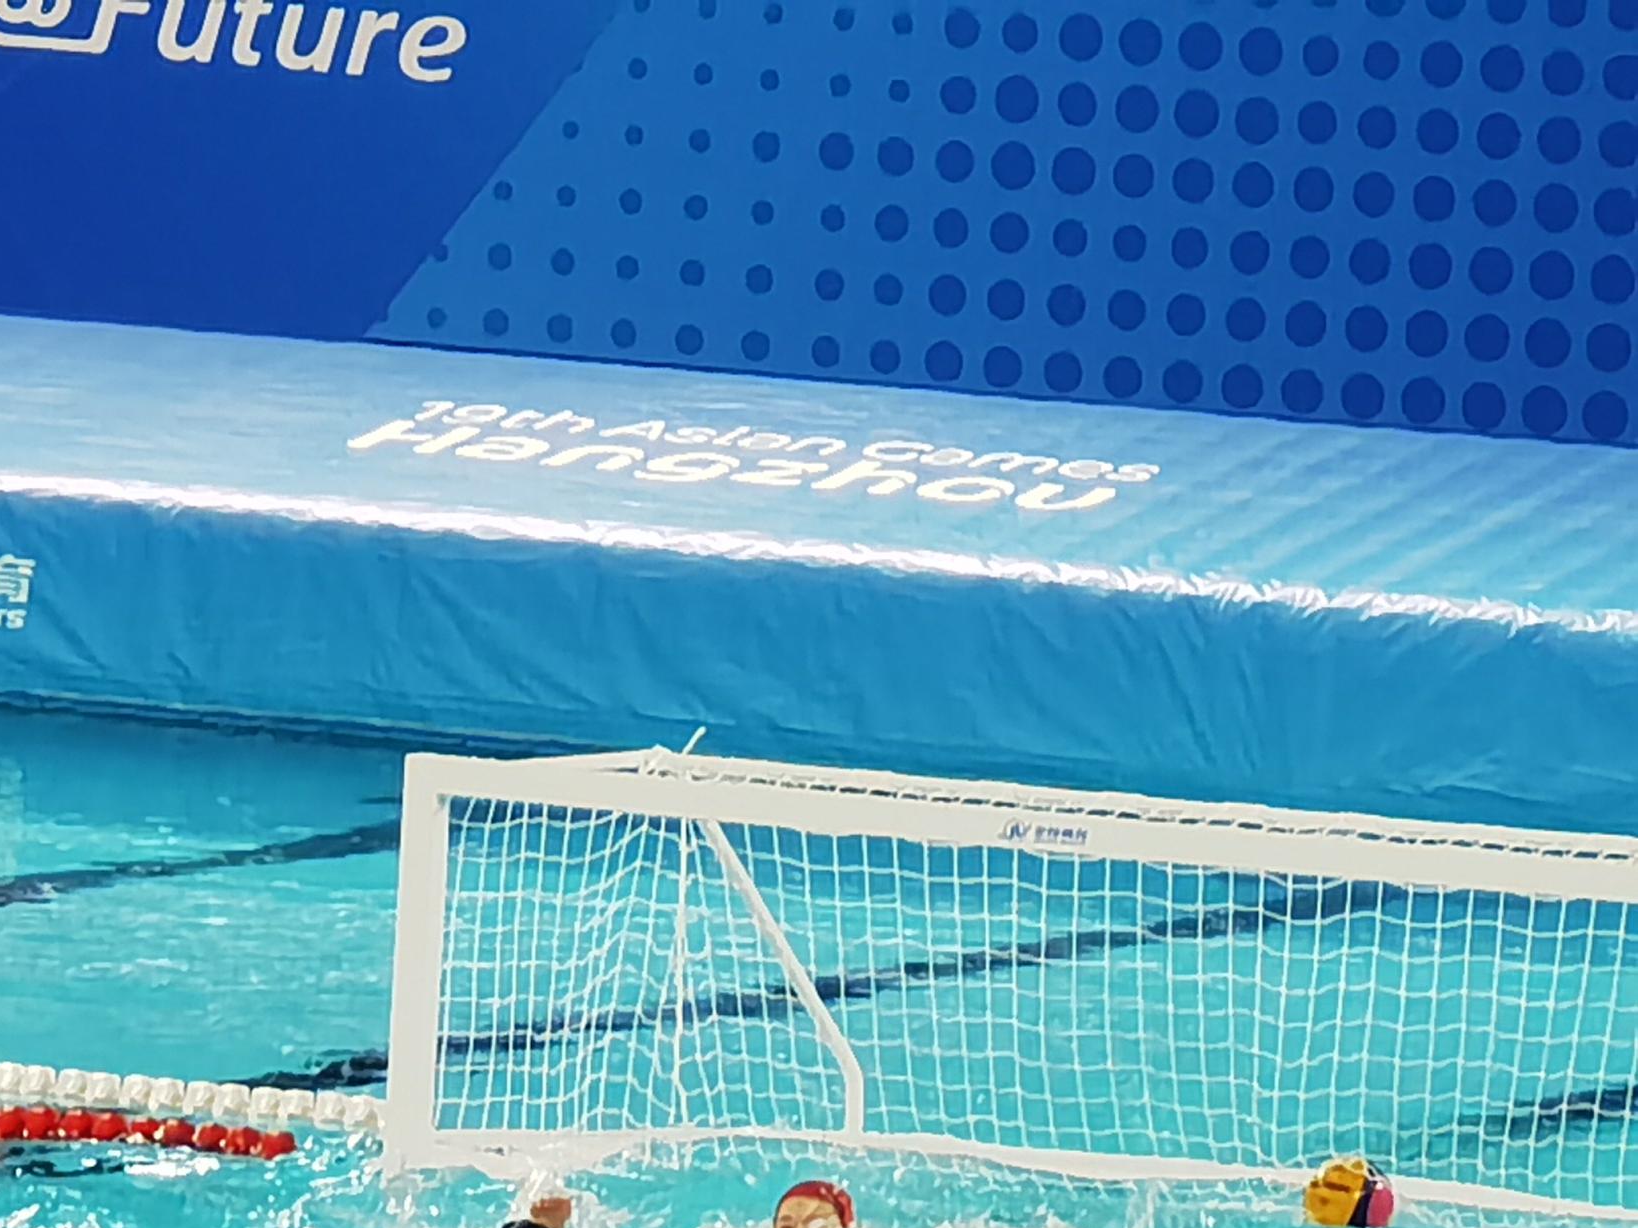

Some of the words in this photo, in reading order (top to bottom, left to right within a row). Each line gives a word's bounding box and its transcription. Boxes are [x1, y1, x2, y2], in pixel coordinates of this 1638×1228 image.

[414, 401, 595, 434] 19th
[599, 420, 846, 456] Asian
[347, 420, 1116, 510] Hangzhou
